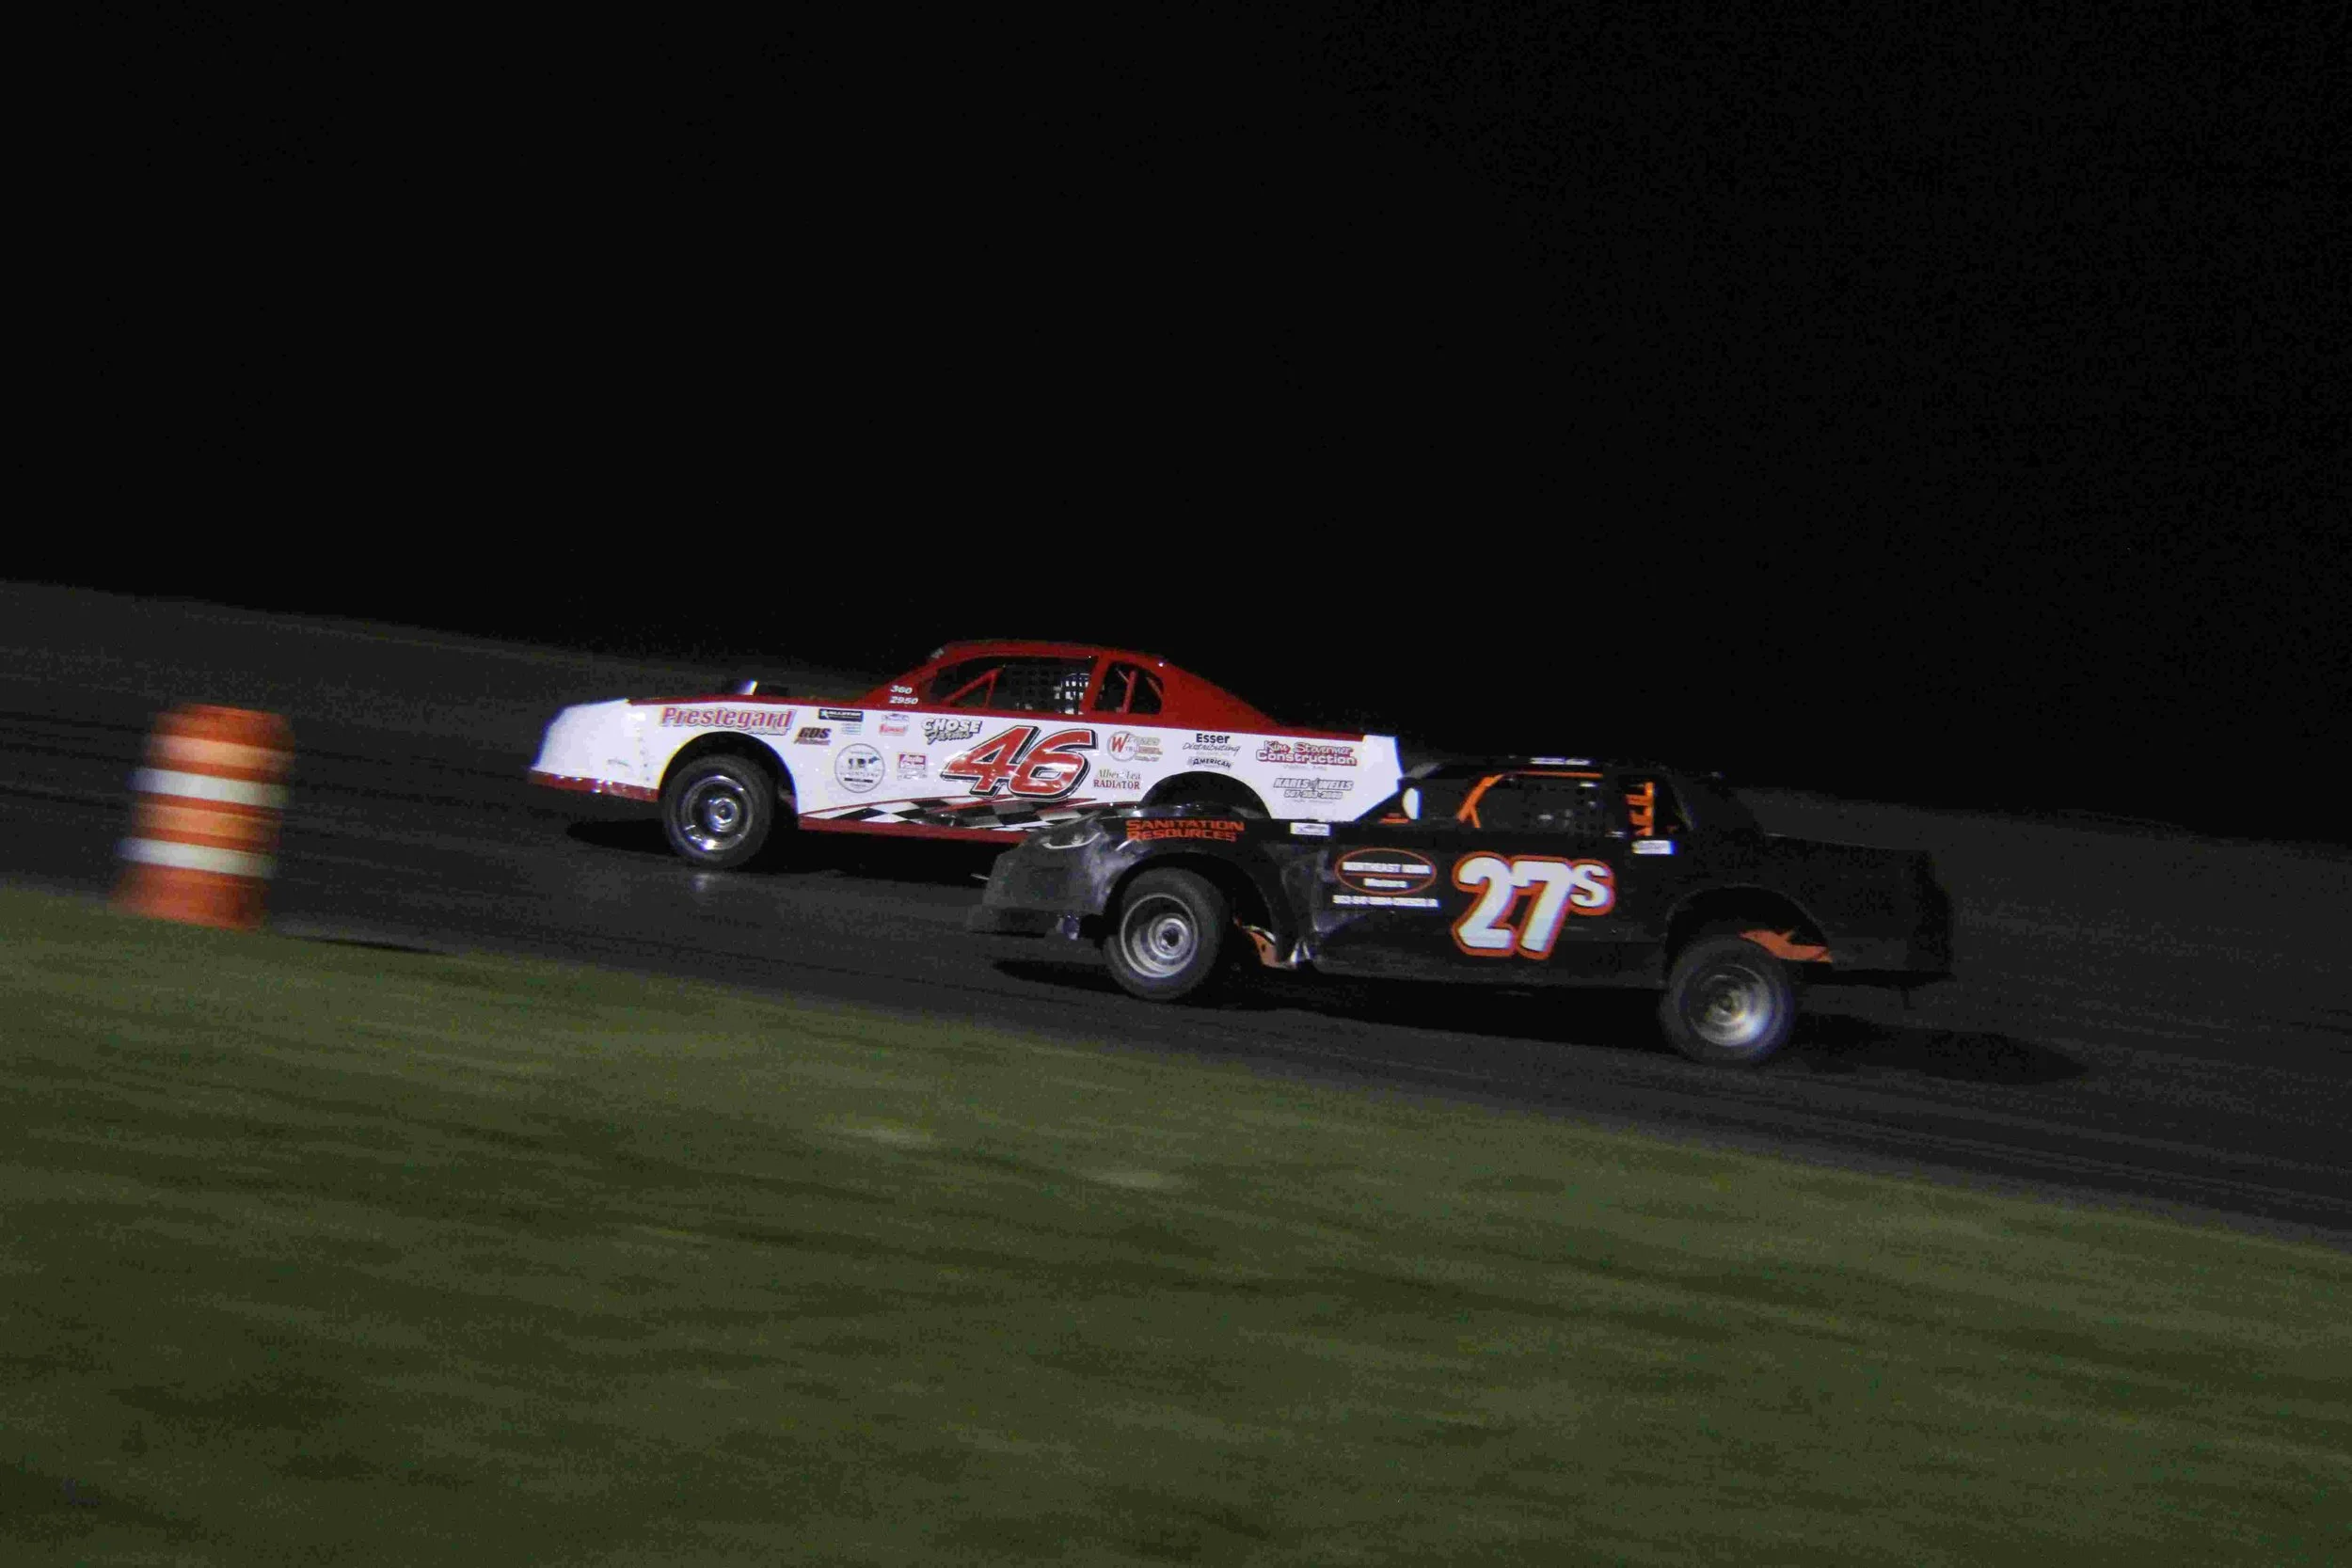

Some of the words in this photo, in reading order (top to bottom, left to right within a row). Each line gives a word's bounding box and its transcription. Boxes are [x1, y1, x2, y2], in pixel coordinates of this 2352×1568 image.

[890, 686, 913, 694] 360
[889, 696, 919, 705] 2950
[661, 706, 796, 729] Prestegard
[922, 718, 982, 734] CHOSE
[1196, 733, 1230, 744] Esser
[1183, 742, 1241, 756] Distributing
[940, 725, 1099, 802] 46
[1193, 758, 1232, 768] AMERICAN
[1256, 750, 1357, 767] Construction
[1093, 780, 1140, 789] RADIATOR
[1318, 779, 1354, 791] WELLS
[1125, 819, 1246, 832] SANITATION
[1126, 829, 1238, 842] RESOURCES
